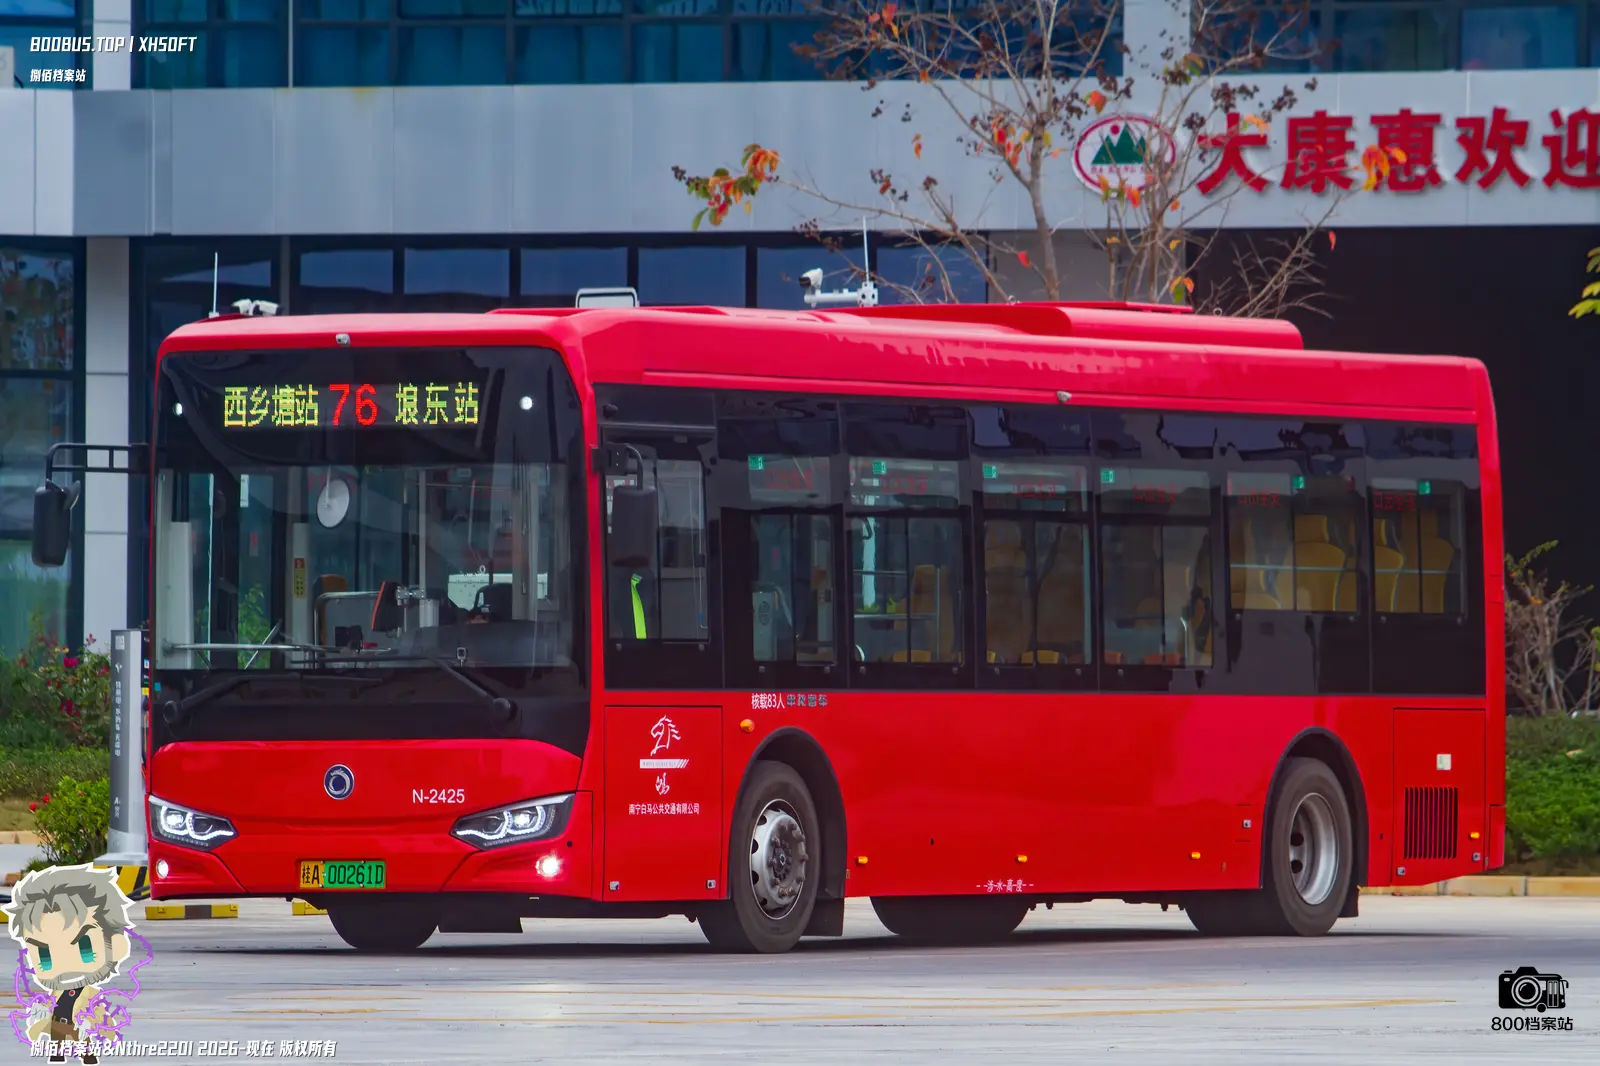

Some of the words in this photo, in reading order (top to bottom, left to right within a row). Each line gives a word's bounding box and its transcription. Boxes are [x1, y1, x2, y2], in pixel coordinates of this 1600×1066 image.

[223, 383, 319, 428] 西乡塘站
[328, 383, 379, 427] 76
[412, 788, 465, 804] N-2425
[628, 803, 700, 815] 南宁白马公共交通有限公司
